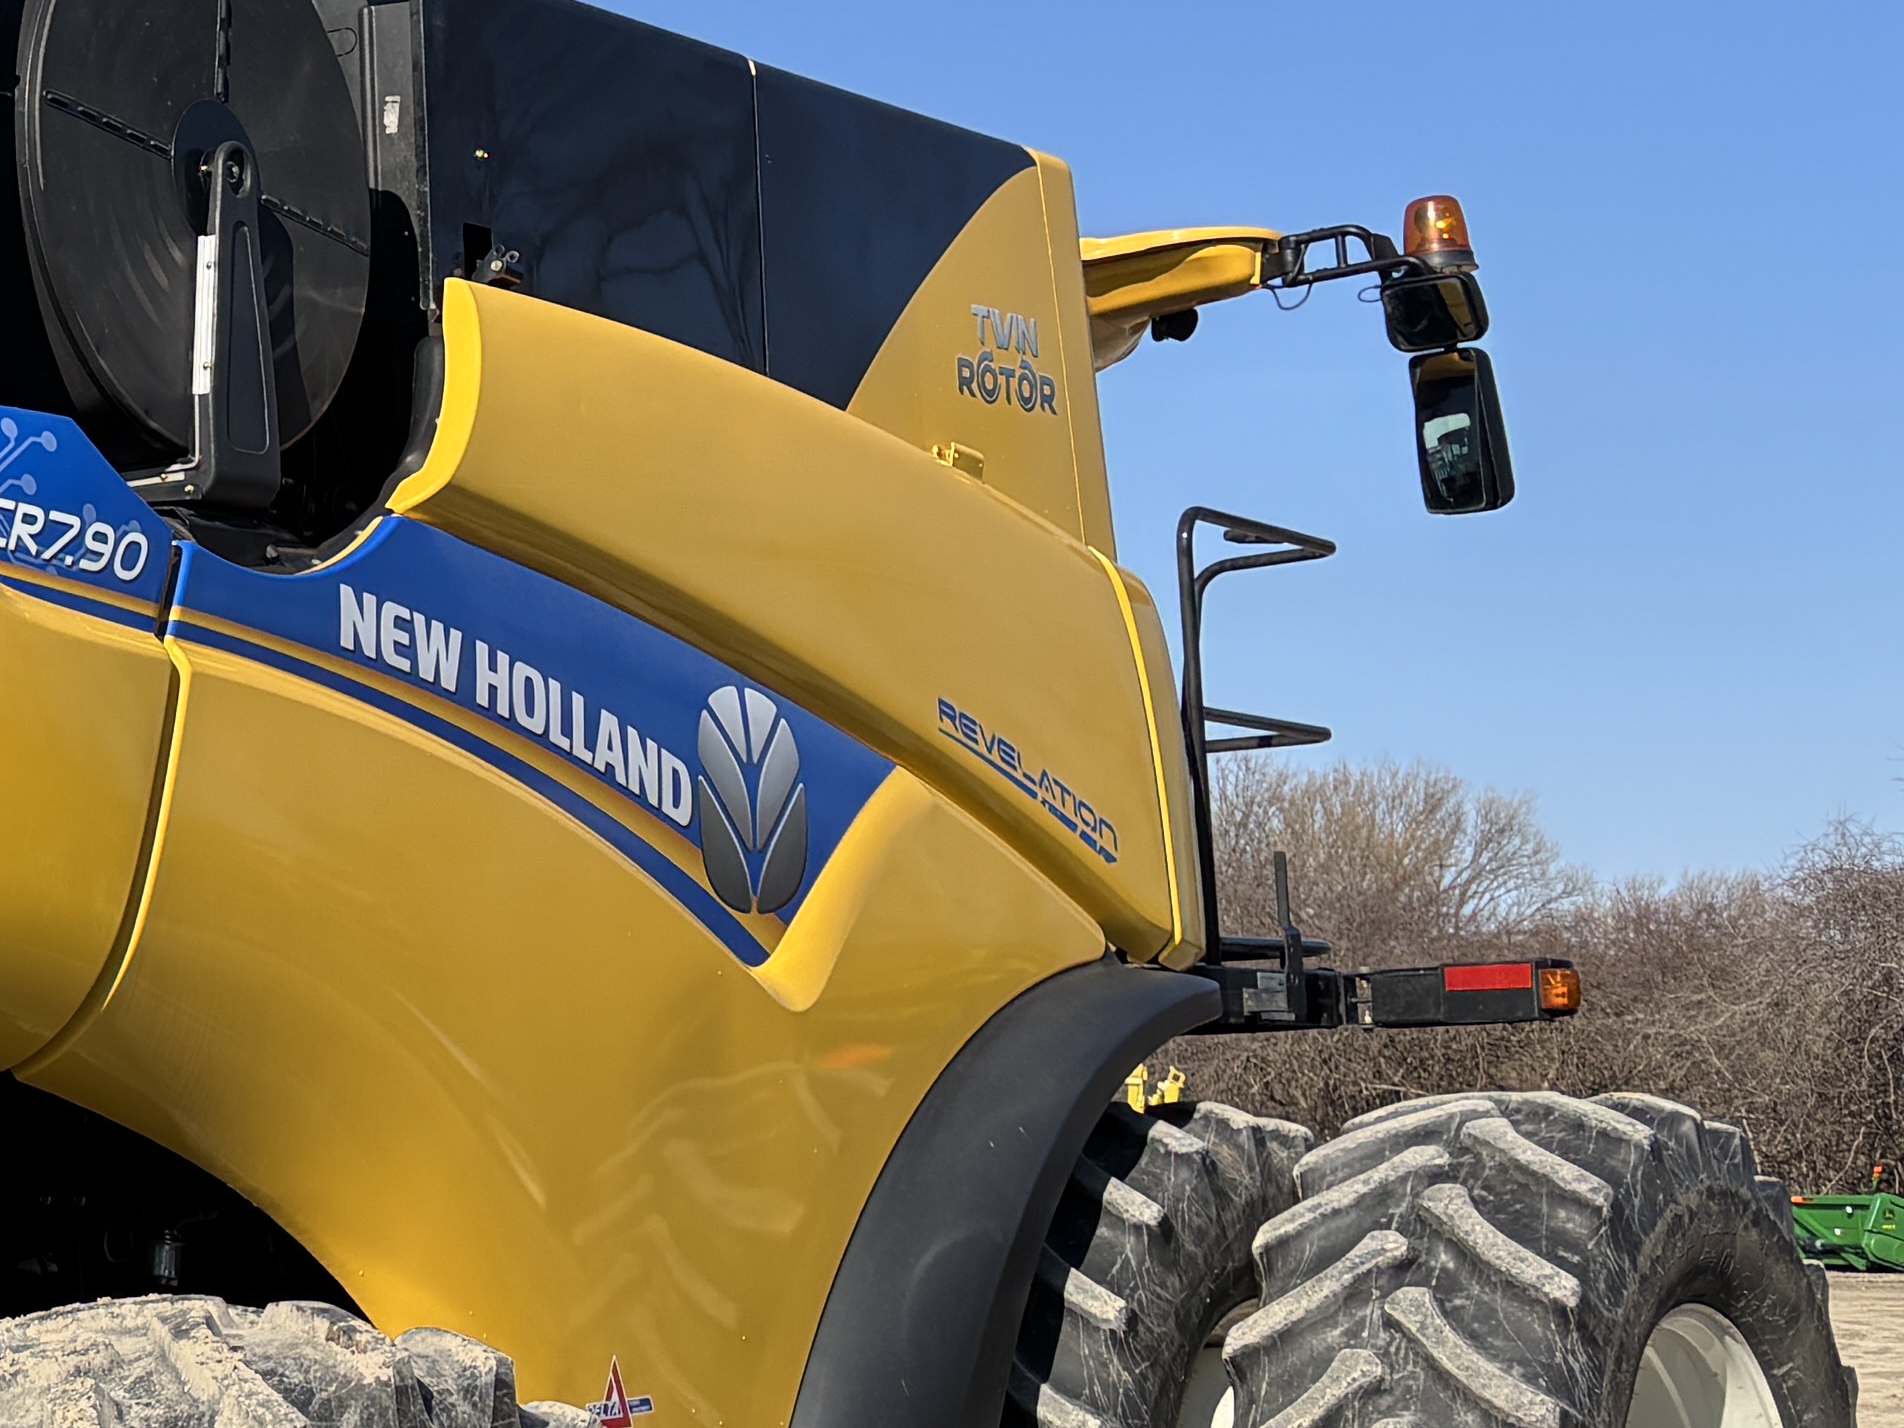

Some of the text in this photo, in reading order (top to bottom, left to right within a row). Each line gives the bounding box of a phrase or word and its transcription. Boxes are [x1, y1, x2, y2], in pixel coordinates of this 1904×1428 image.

[957, 350, 1057, 415] ROTOR
[971, 304, 1038, 357] TWIN
[339, 583, 693, 827] NEW HOLLAND
[938, 697, 1118, 852] REVELATION
